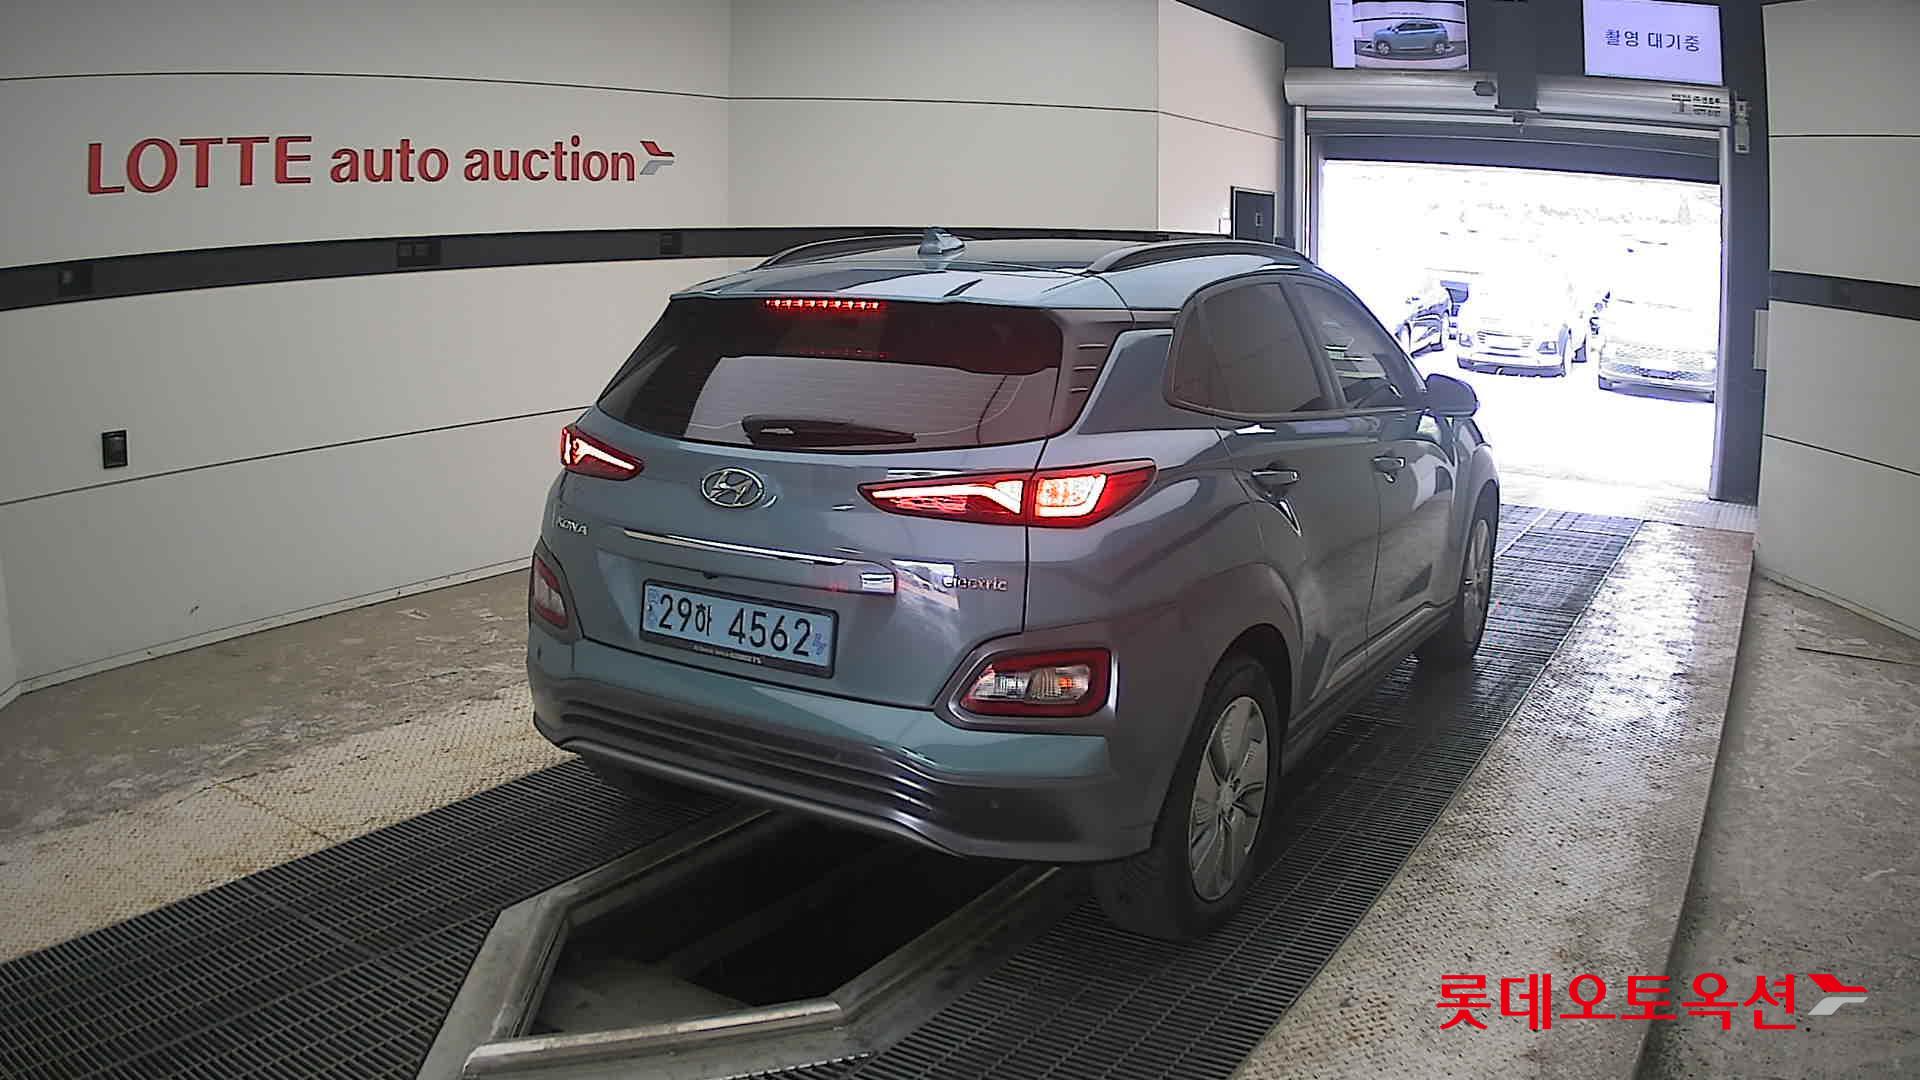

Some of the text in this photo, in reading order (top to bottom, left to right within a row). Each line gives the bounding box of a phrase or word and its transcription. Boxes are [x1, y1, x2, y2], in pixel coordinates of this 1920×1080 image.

[1605, 29, 1700, 52] 촬영 대기중
[88, 135, 636, 195] LOTTE auto auction
[658, 594, 713, 637] 29하
[728, 607, 811, 657] 4562
